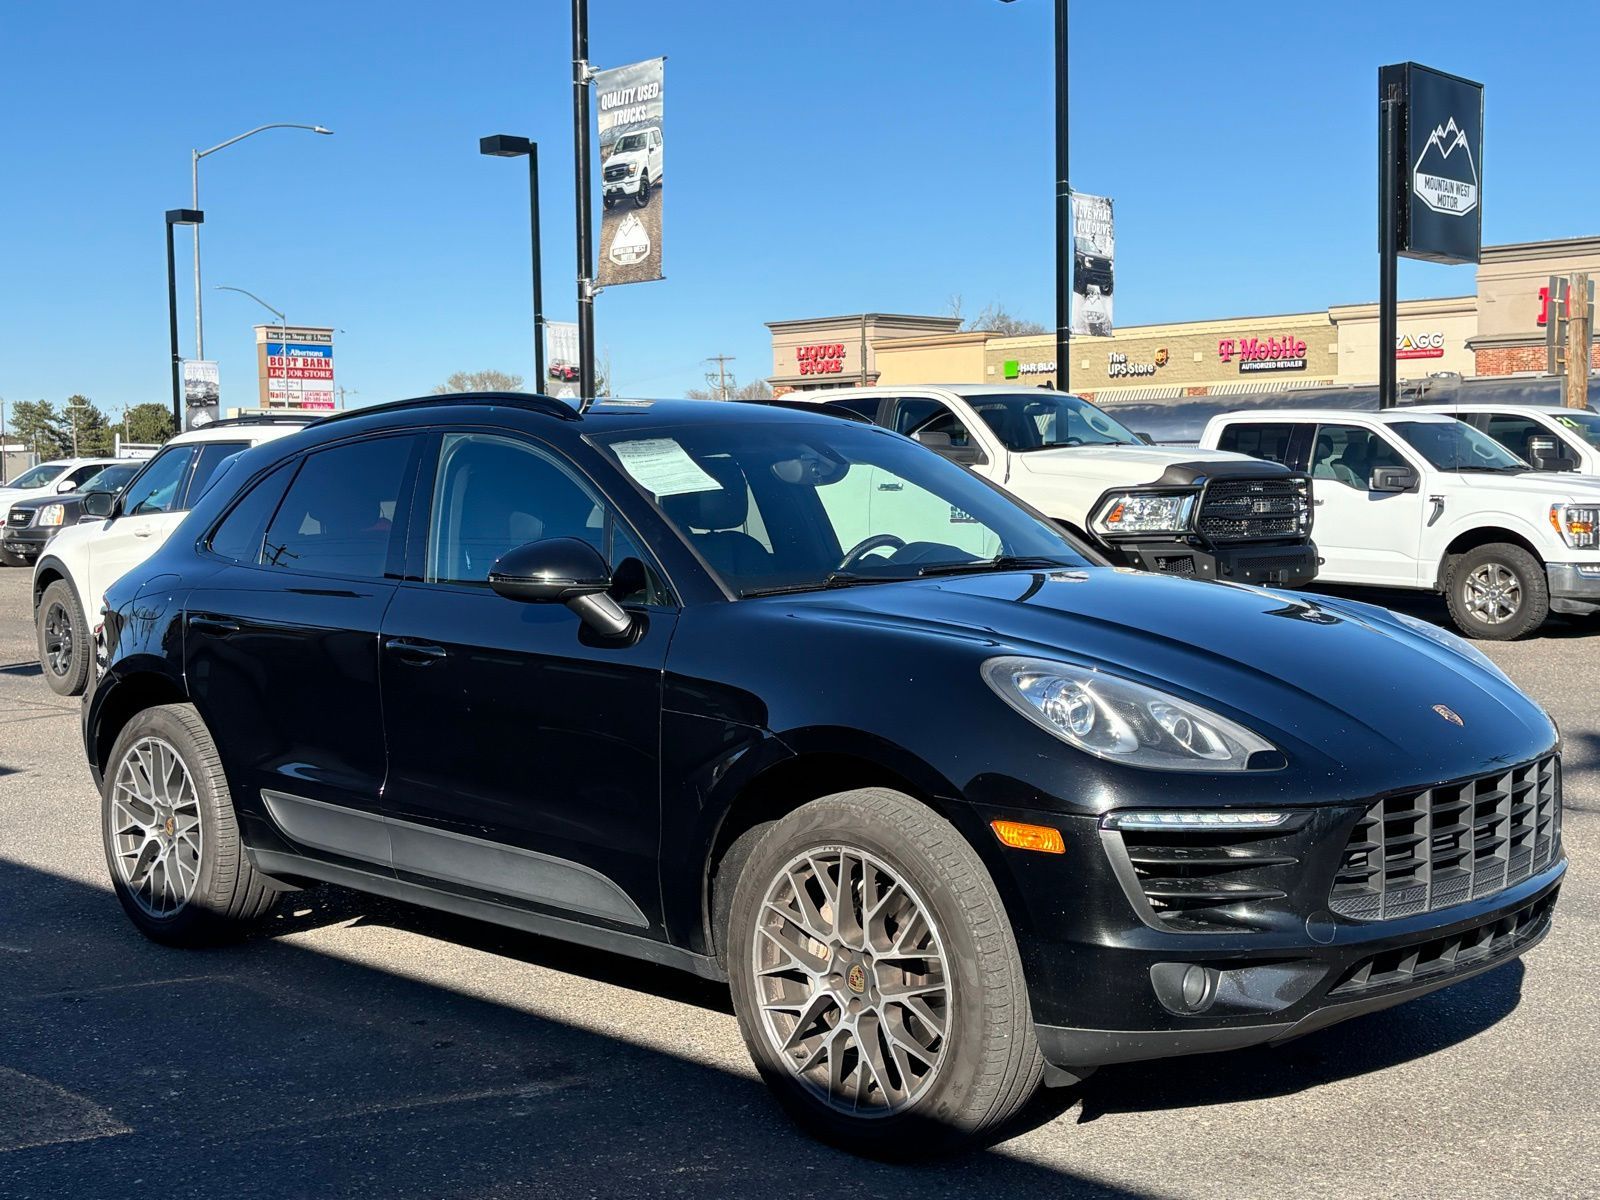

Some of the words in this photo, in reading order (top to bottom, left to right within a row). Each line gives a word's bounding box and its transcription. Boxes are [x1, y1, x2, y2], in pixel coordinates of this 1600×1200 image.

[601, 87, 636, 110] QUALITY
[637, 82, 659, 101] USED
[613, 104, 646, 126] TRUCKS
[1424, 176, 1455, 194] MOUNTAIN
[1455, 180, 1470, 198] WEST
[1437, 193, 1458, 208] MOTOR
[290, 349, 324, 357] Albertsons
[797, 344, 846, 361] LIQUOR
[1108, 352, 1126, 362] The
[270, 357, 298, 367] BOOT
[302, 358, 330, 368] BARN
[800, 360, 841, 375] STORE
[1037, 361, 1057, 372] BLO
[1241, 362, 1277, 370] AUTHORIZED
[1276, 360, 1303, 368] RETAILER
[270, 369, 303, 378] LIQUOR
[304, 370, 332, 378] STORE
[1108, 363, 1127, 376] UPS
[1127, 363, 1155, 374] Store
[1556, 416, 1578, 427] 21
